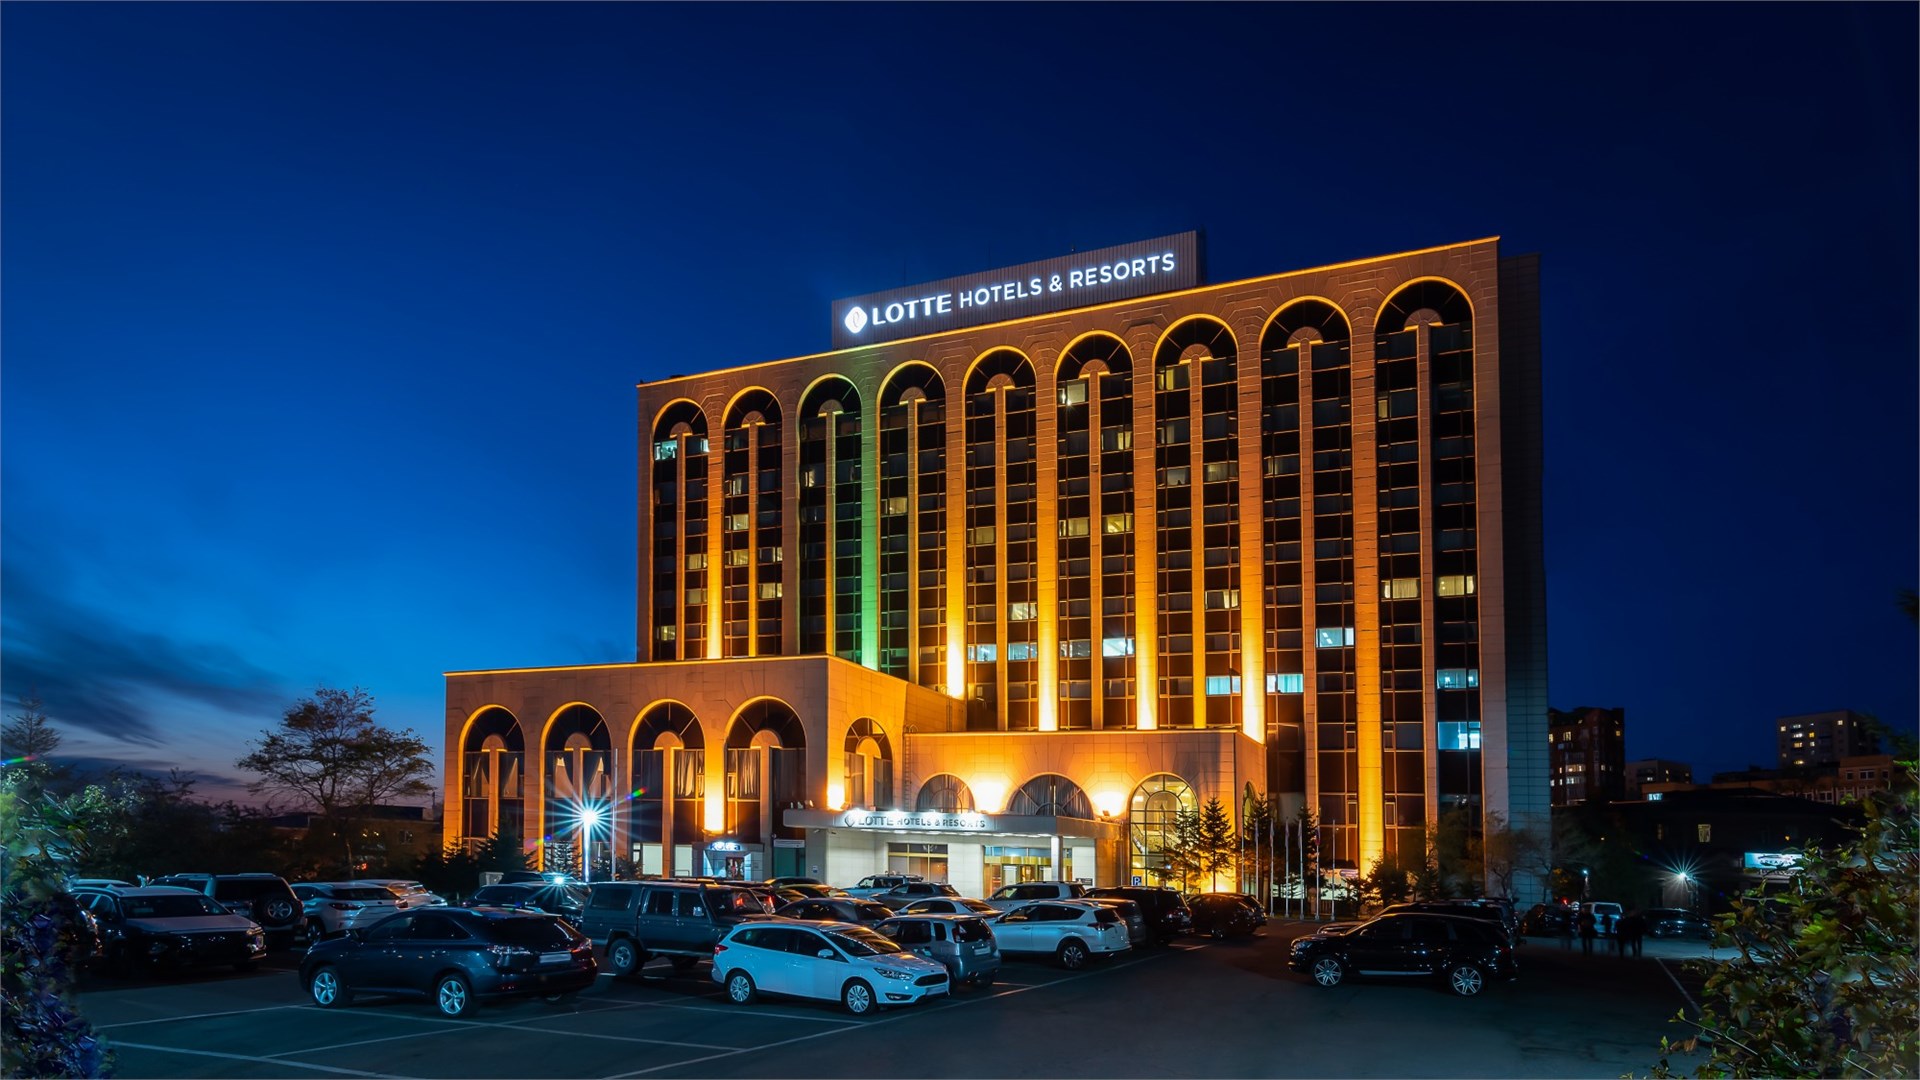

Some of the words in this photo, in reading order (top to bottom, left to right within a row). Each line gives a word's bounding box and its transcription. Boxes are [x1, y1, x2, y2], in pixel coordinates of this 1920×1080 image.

[872, 294, 952, 325] LOTTE
[959, 278, 1042, 309] HOTELS
[1049, 275, 1063, 292] &
[1070, 253, 1175, 289] RESORTS
[858, 816, 894, 826] LOTTE
